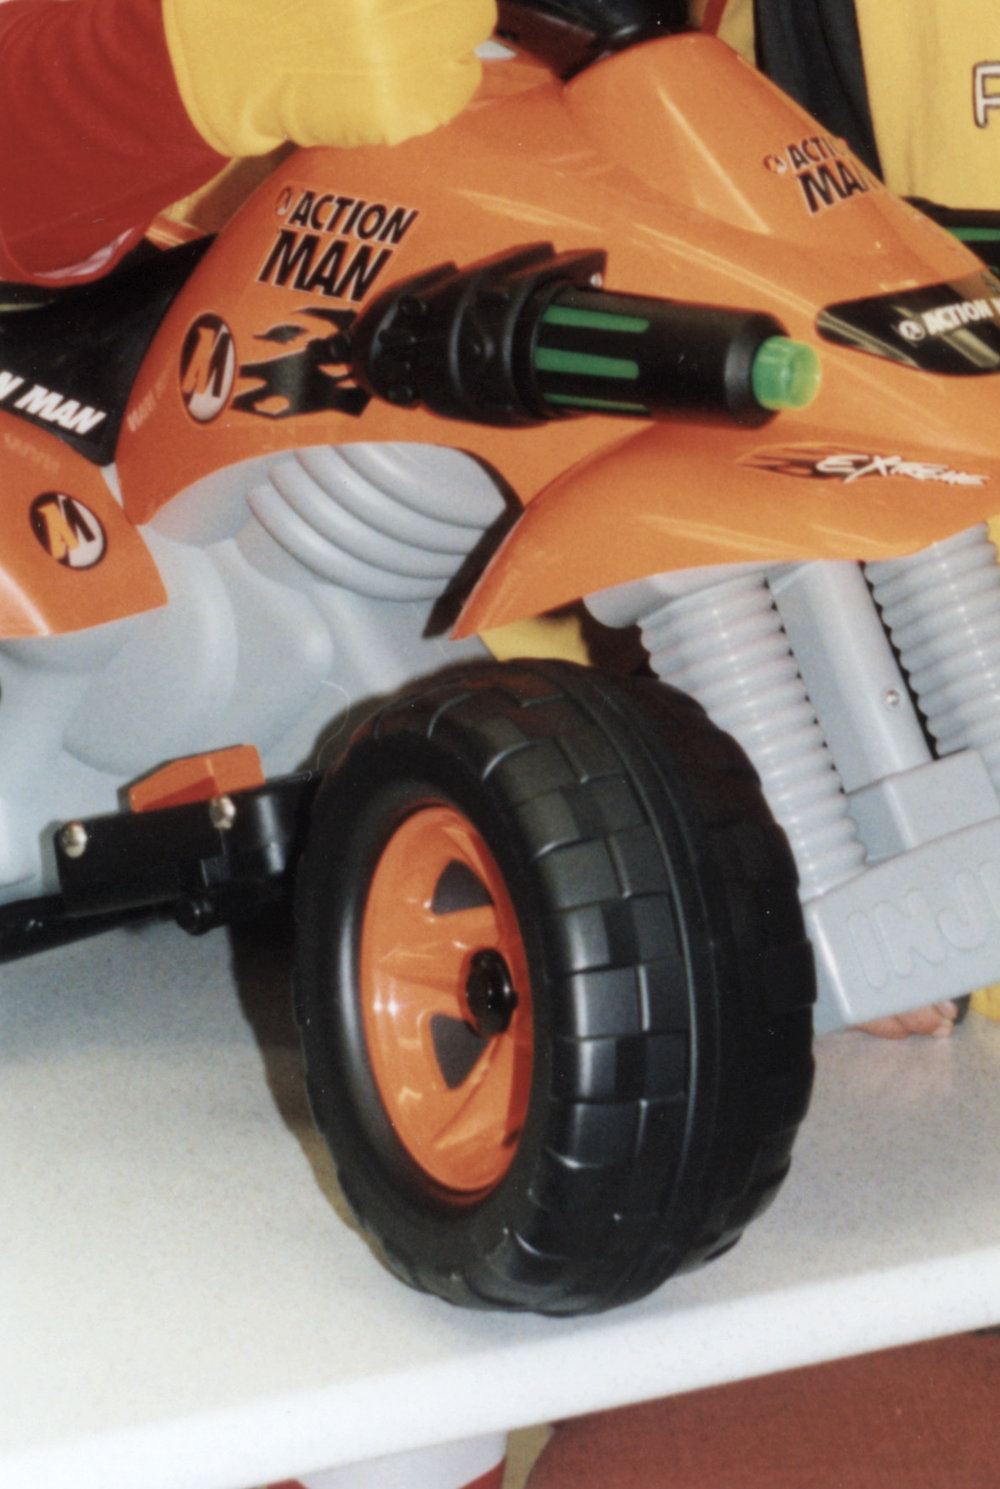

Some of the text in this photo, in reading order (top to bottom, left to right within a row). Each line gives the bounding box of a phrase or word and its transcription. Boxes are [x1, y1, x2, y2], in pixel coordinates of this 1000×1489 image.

[786, 136, 843, 171] ACTI
[287, 189, 420, 245] ACTION
[256, 228, 394, 303] MAN
[921, 299, 994, 336] ACTION
[14, 384, 107, 435] MAN
